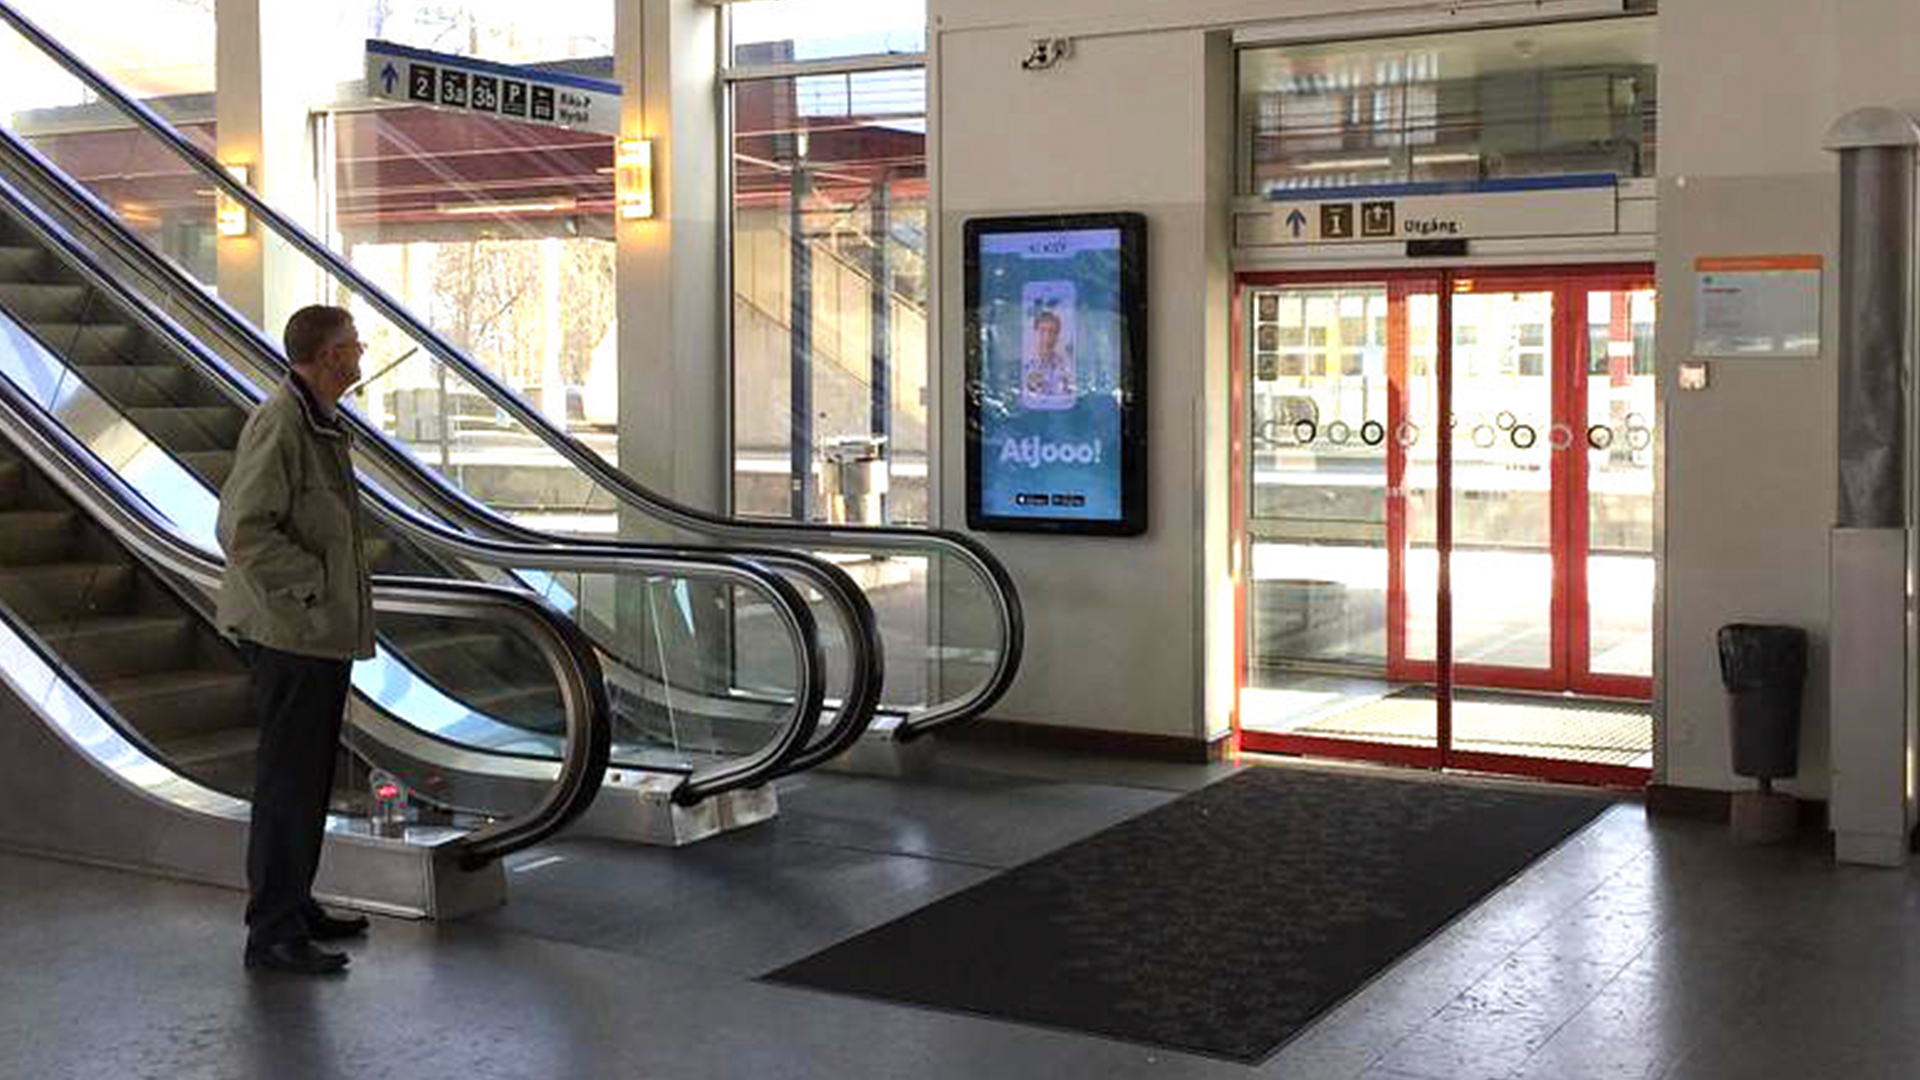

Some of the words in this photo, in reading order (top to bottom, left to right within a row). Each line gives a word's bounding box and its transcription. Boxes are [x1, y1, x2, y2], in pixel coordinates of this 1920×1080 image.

[416, 76, 428, 97] 2
[444, 80, 465, 103] 3a
[473, 86, 496, 108] 3b
[508, 84, 520, 102] P
[1404, 218, 1458, 234] Utgång
